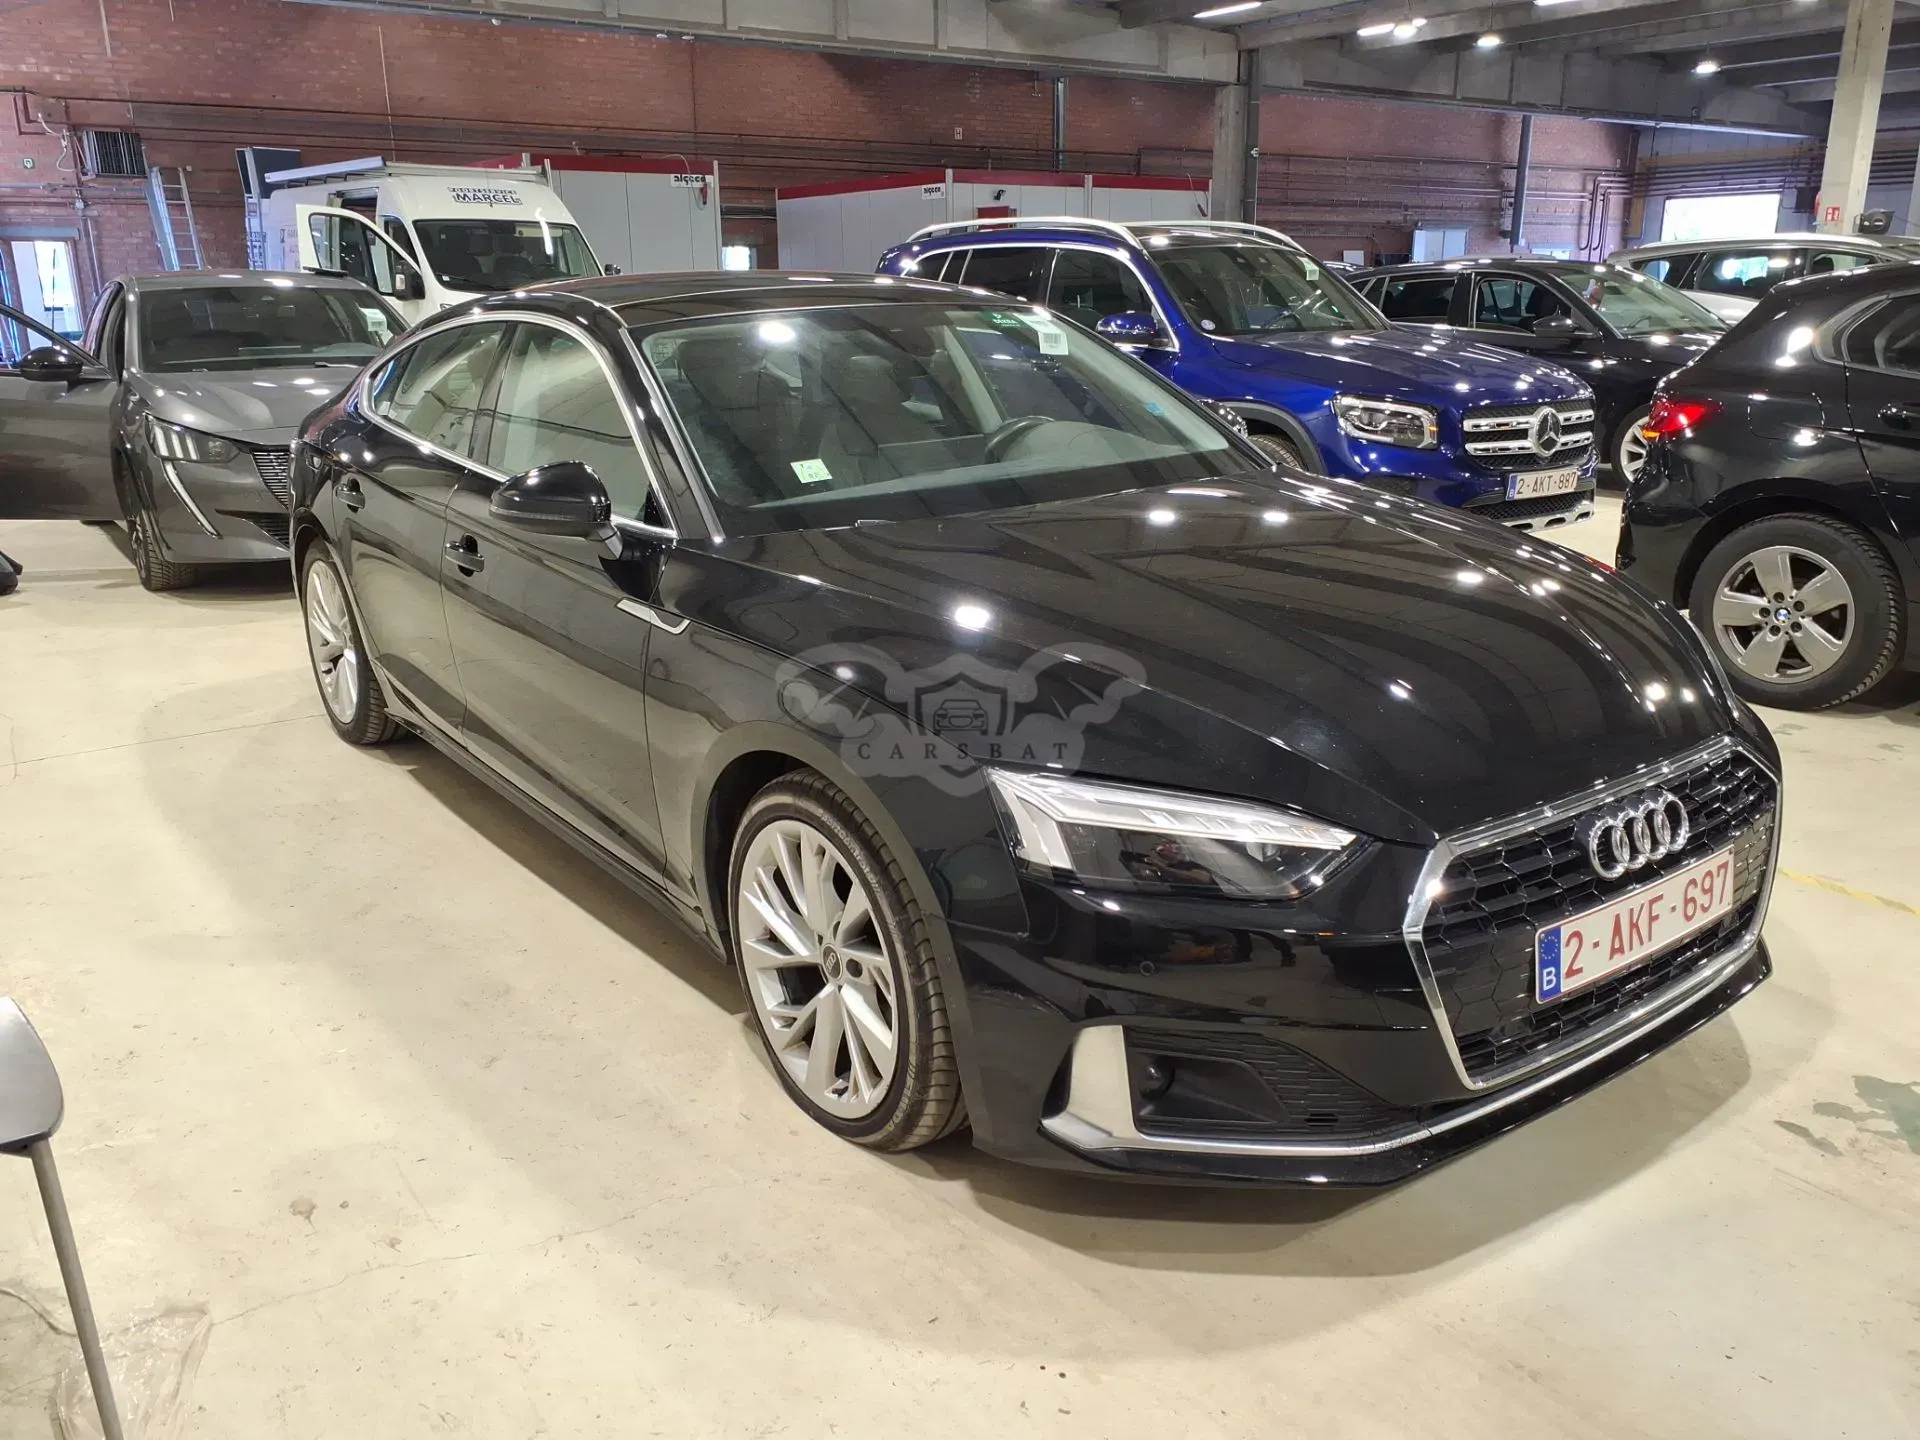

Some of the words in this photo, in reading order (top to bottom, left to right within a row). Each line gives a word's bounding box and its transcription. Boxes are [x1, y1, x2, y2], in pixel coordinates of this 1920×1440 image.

[456, 193, 520, 204] MARCEL
[1516, 472, 1577, 495] 2-AKT-887
[1564, 860, 1729, 980] 2-AKF-697
[1542, 966, 1557, 992] B
